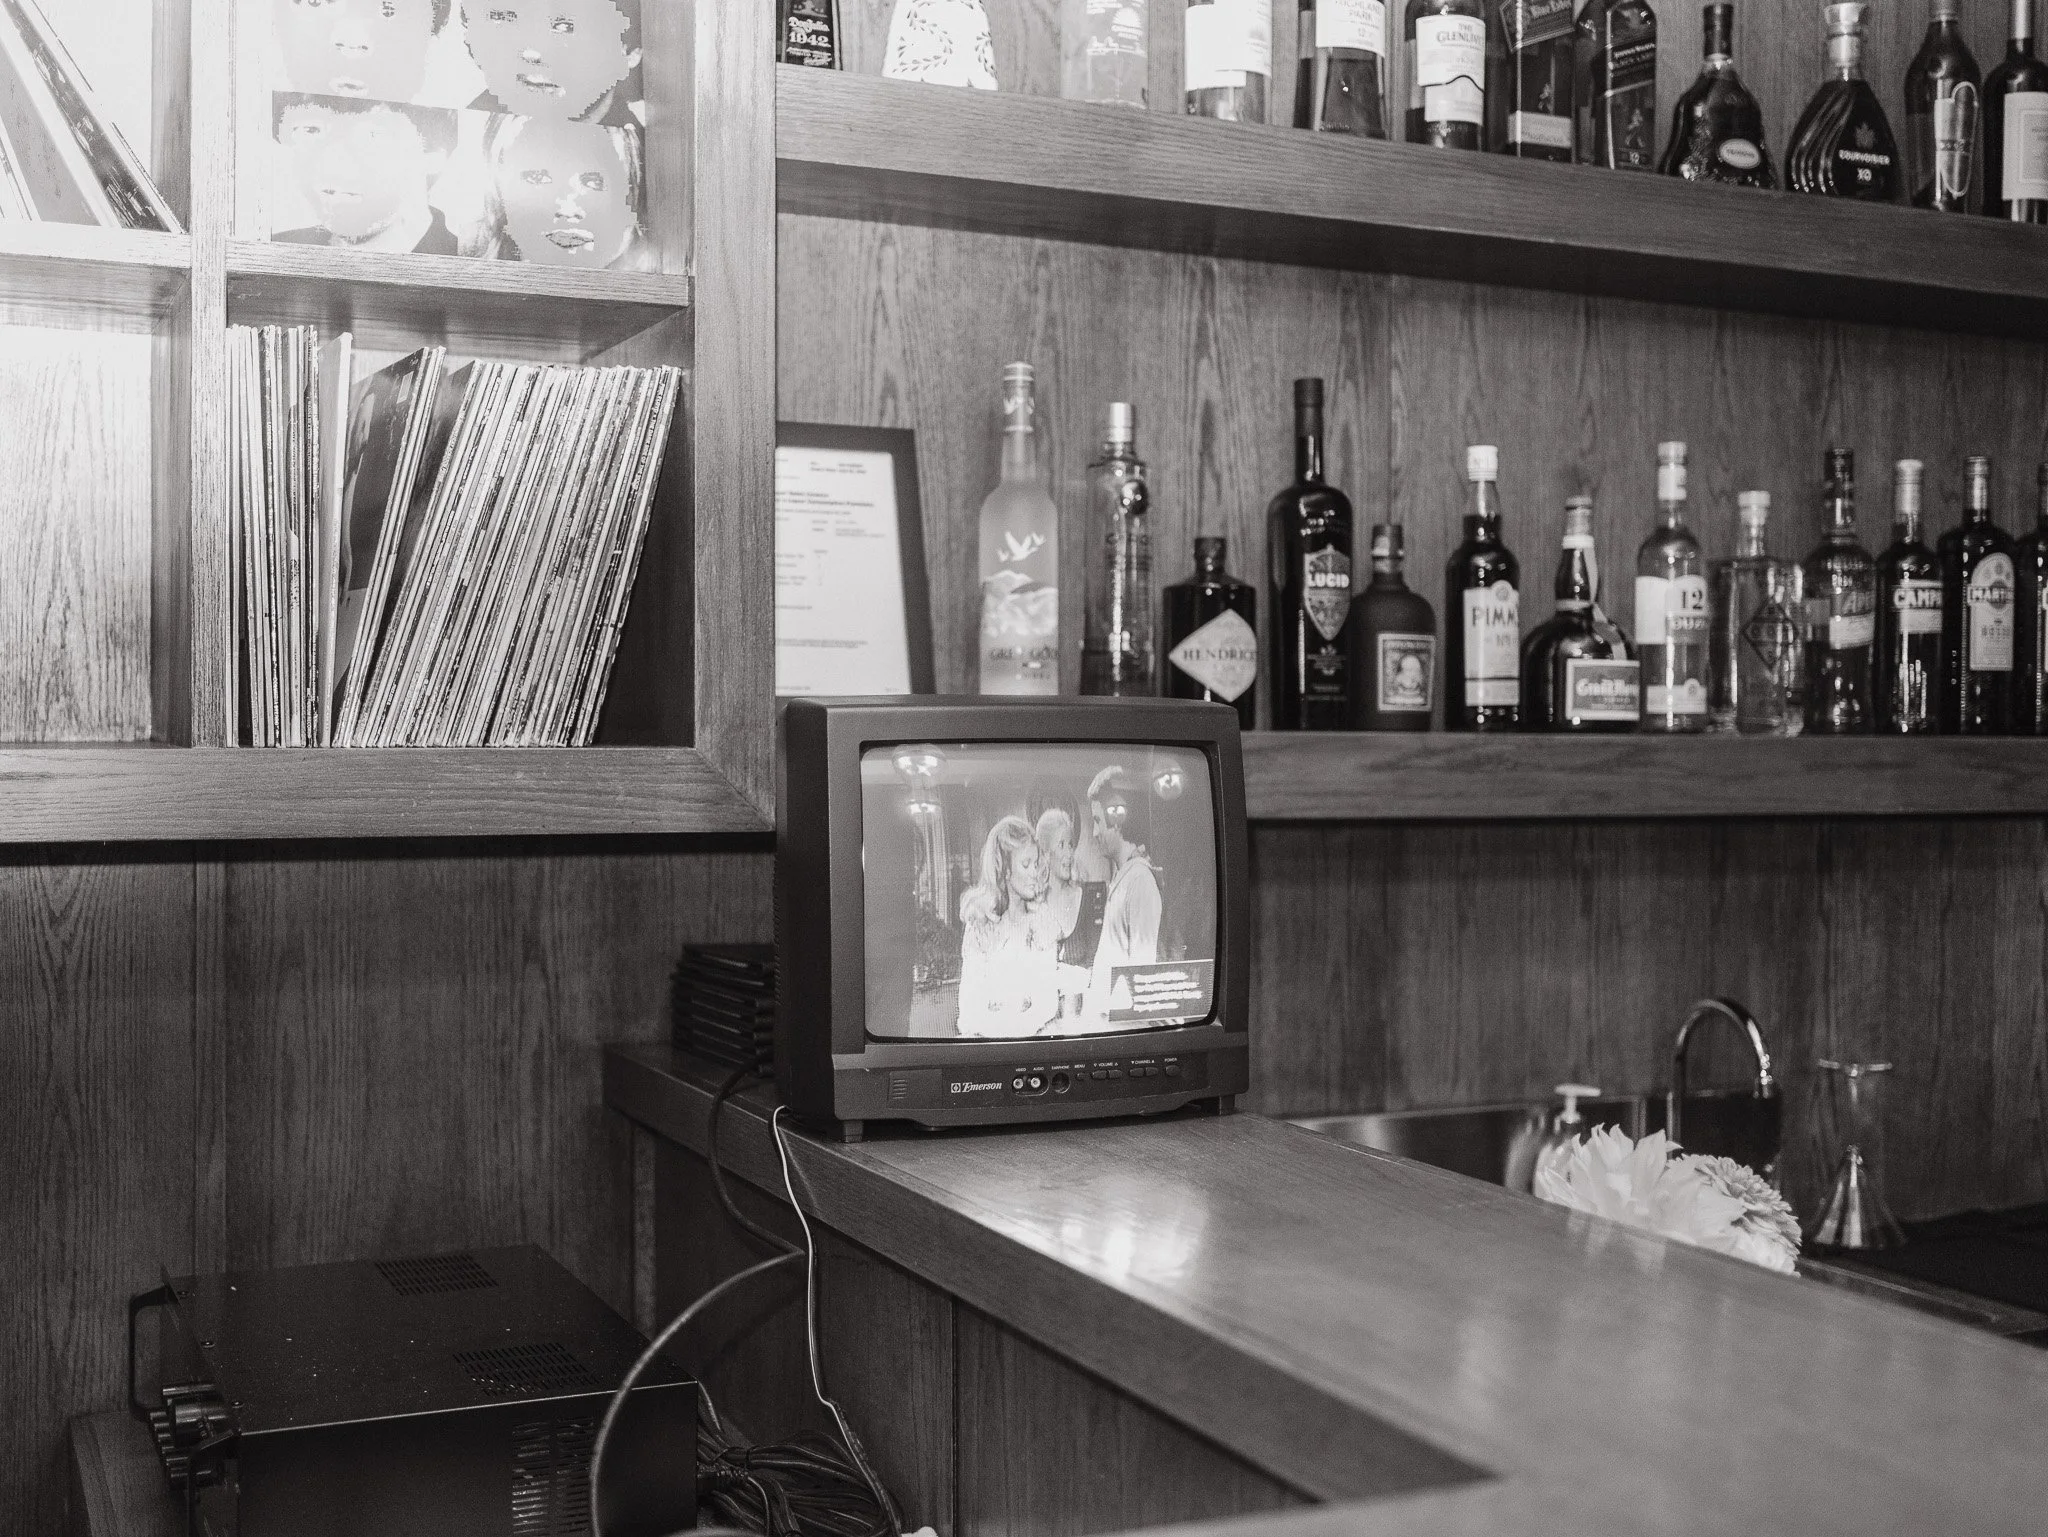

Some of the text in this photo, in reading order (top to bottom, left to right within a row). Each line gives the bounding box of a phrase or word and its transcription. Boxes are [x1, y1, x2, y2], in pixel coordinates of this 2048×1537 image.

[1856, 167, 1873, 182] XO
[1306, 572, 1350, 588] LUCID
[1681, 586, 1703, 610] 12
[961, 1081, 1003, 1093] Emerson
